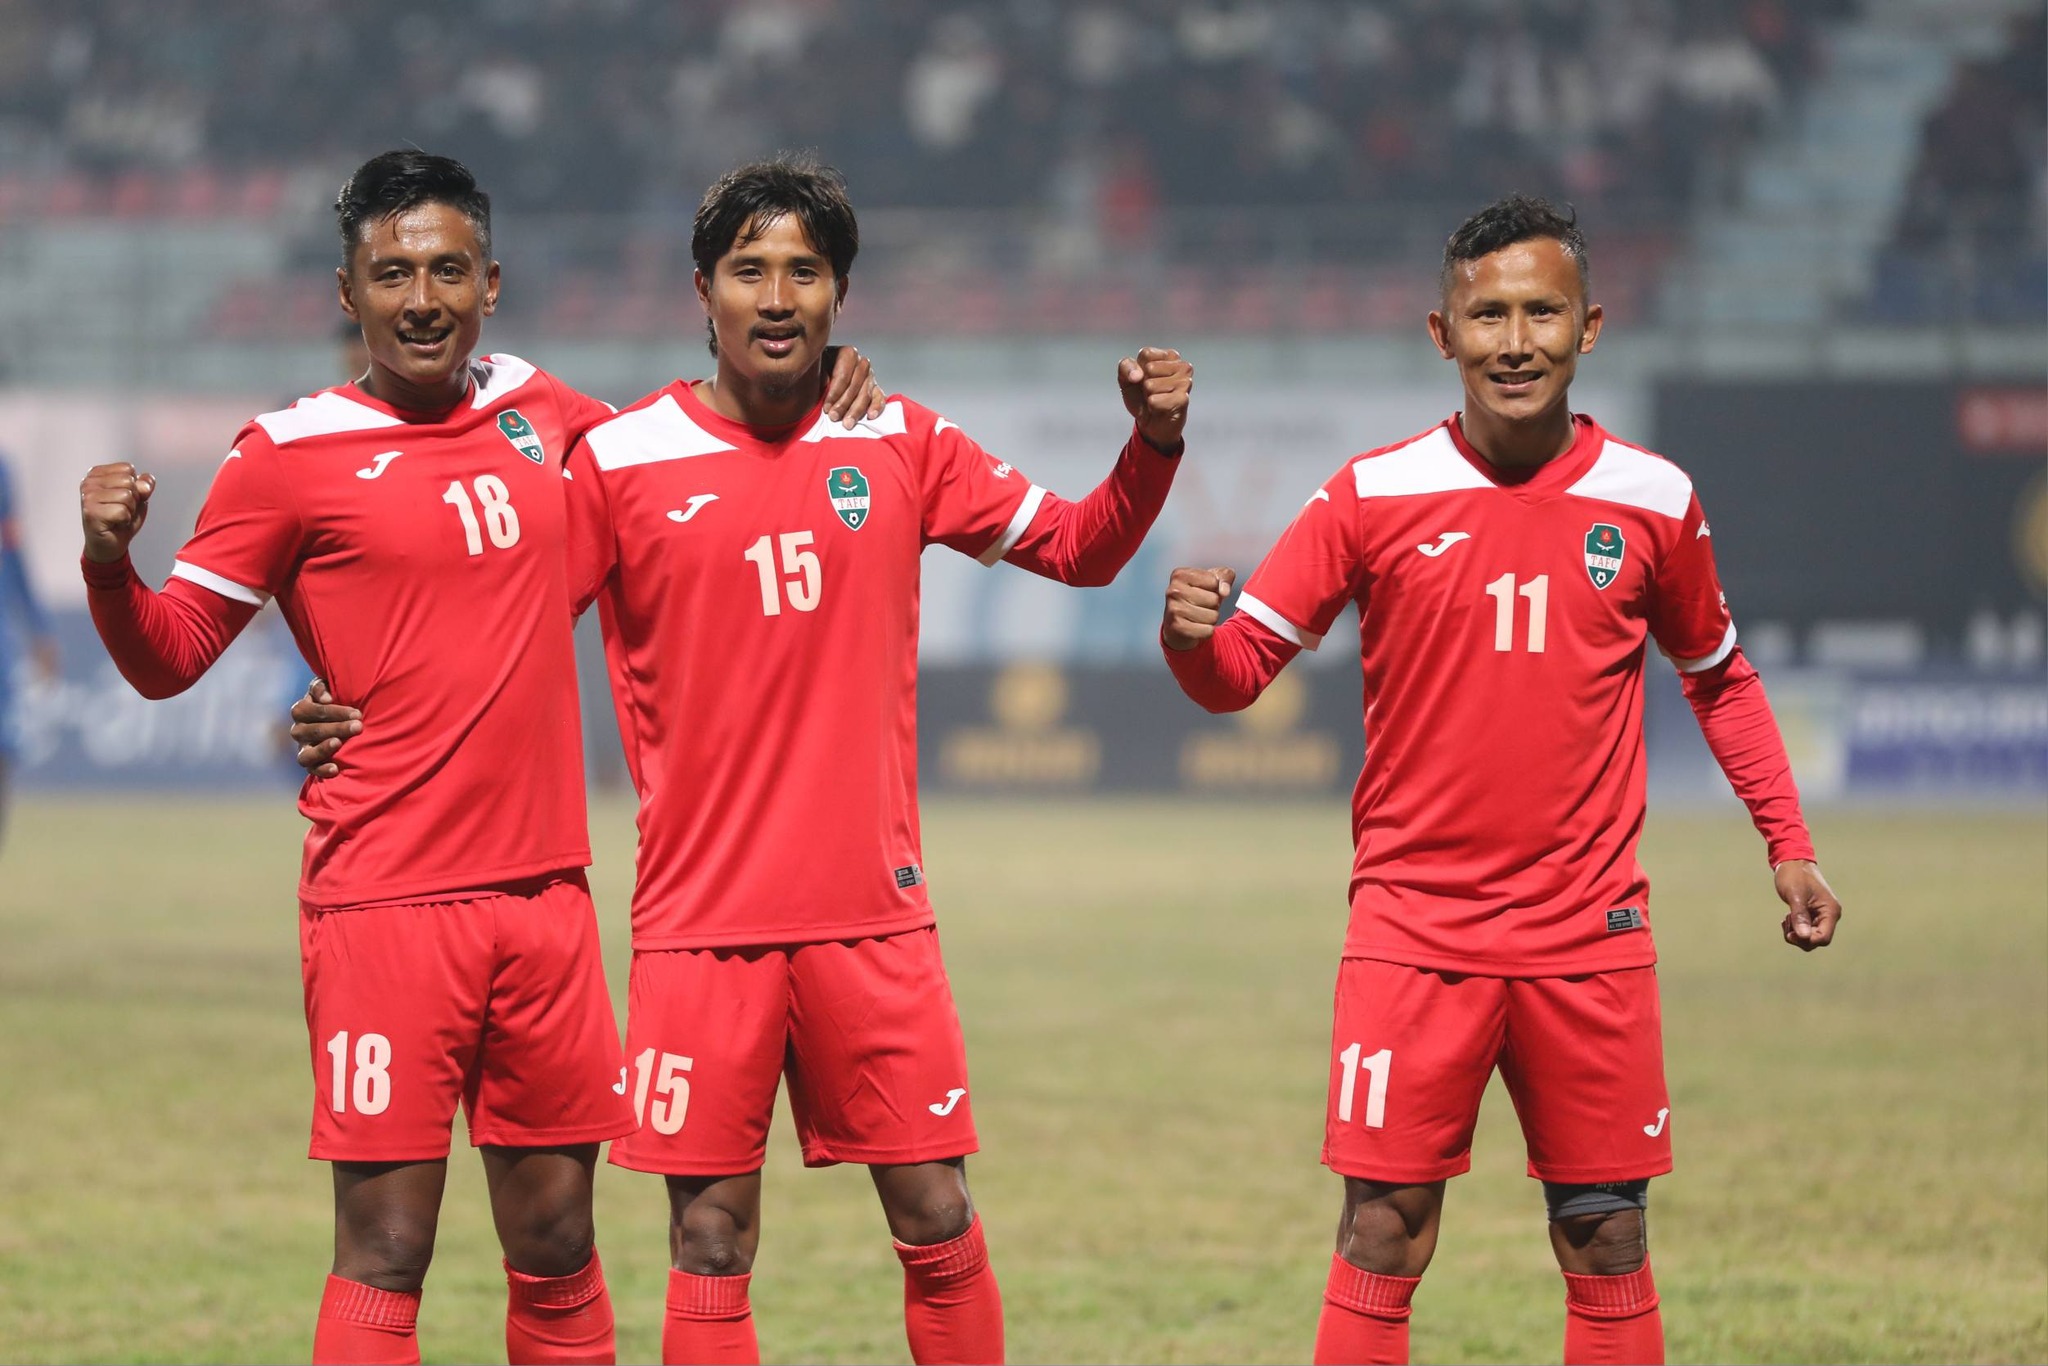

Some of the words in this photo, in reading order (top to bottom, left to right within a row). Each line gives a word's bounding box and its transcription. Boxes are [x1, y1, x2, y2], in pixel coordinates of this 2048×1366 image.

[442, 474, 520, 556] 18
[837, 497, 866, 509] TAFC
[744, 530, 822, 616] 15
[1591, 555, 1618, 570] TAFC
[1486, 572, 1549, 653] 11
[327, 1030, 392, 1116] 18
[633, 1047, 694, 1136] 15
[1339, 1042, 1393, 1129] 11
